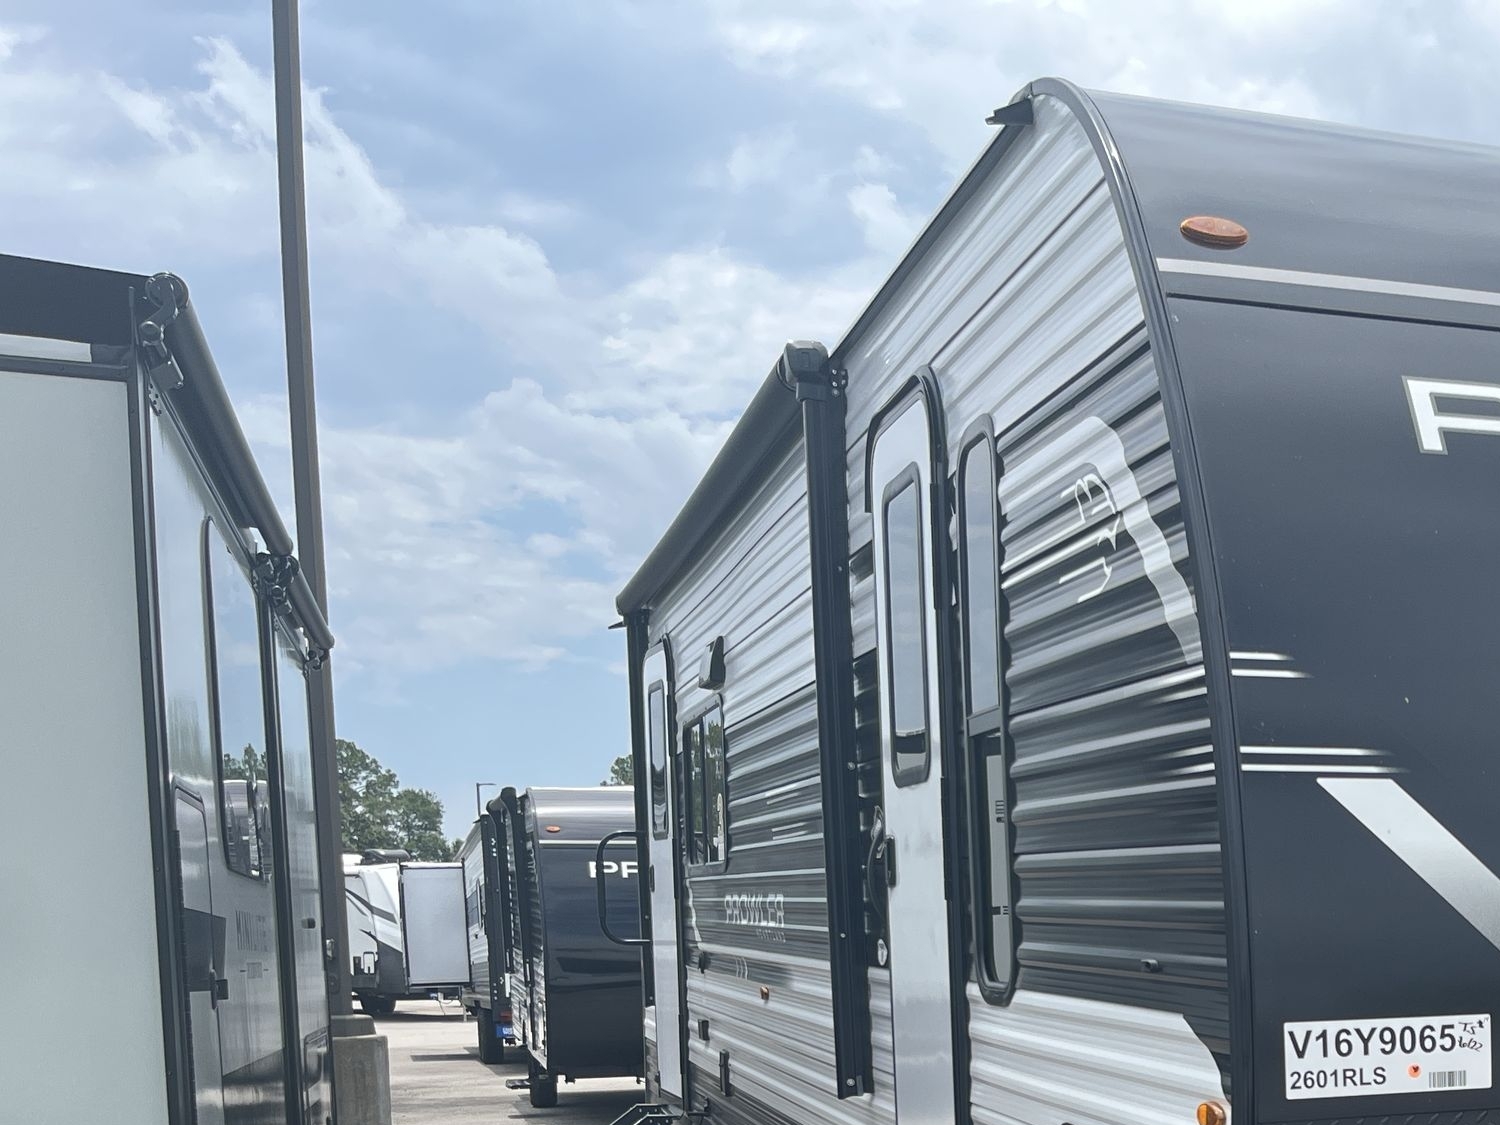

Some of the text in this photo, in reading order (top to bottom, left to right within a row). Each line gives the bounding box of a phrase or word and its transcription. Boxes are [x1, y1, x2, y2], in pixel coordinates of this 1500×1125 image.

[724, 893, 785, 928] PROWLER
[1288, 1024, 1456, 1059] V16Y9065
[1290, 1066, 1387, 1090] 2601RLS
